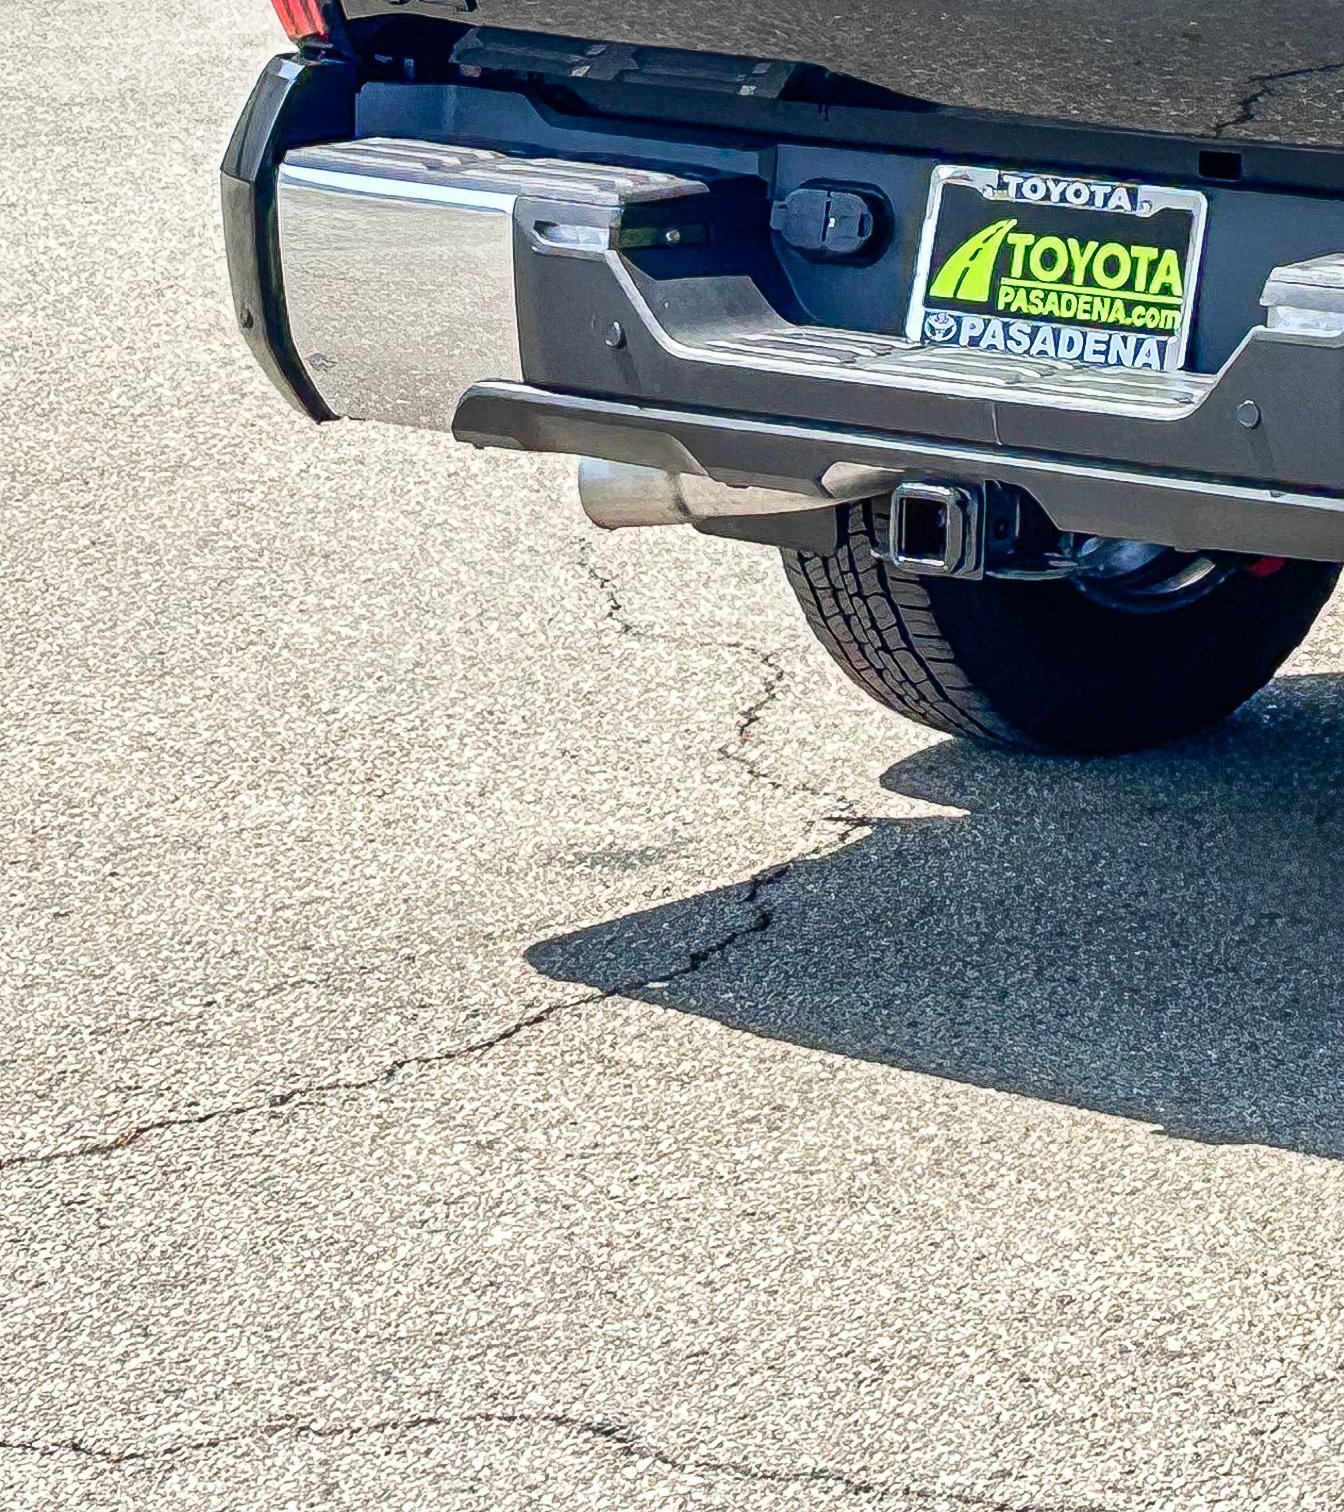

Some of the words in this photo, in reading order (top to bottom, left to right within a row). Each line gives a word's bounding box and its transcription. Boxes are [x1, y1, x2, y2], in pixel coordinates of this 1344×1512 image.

[1003, 173, 1132, 211] TOYOTA
[1007, 232, 1183, 296] TOYOTA
[997, 285, 1182, 330] PASADENA.com
[959, 316, 1162, 371] PASADENA
